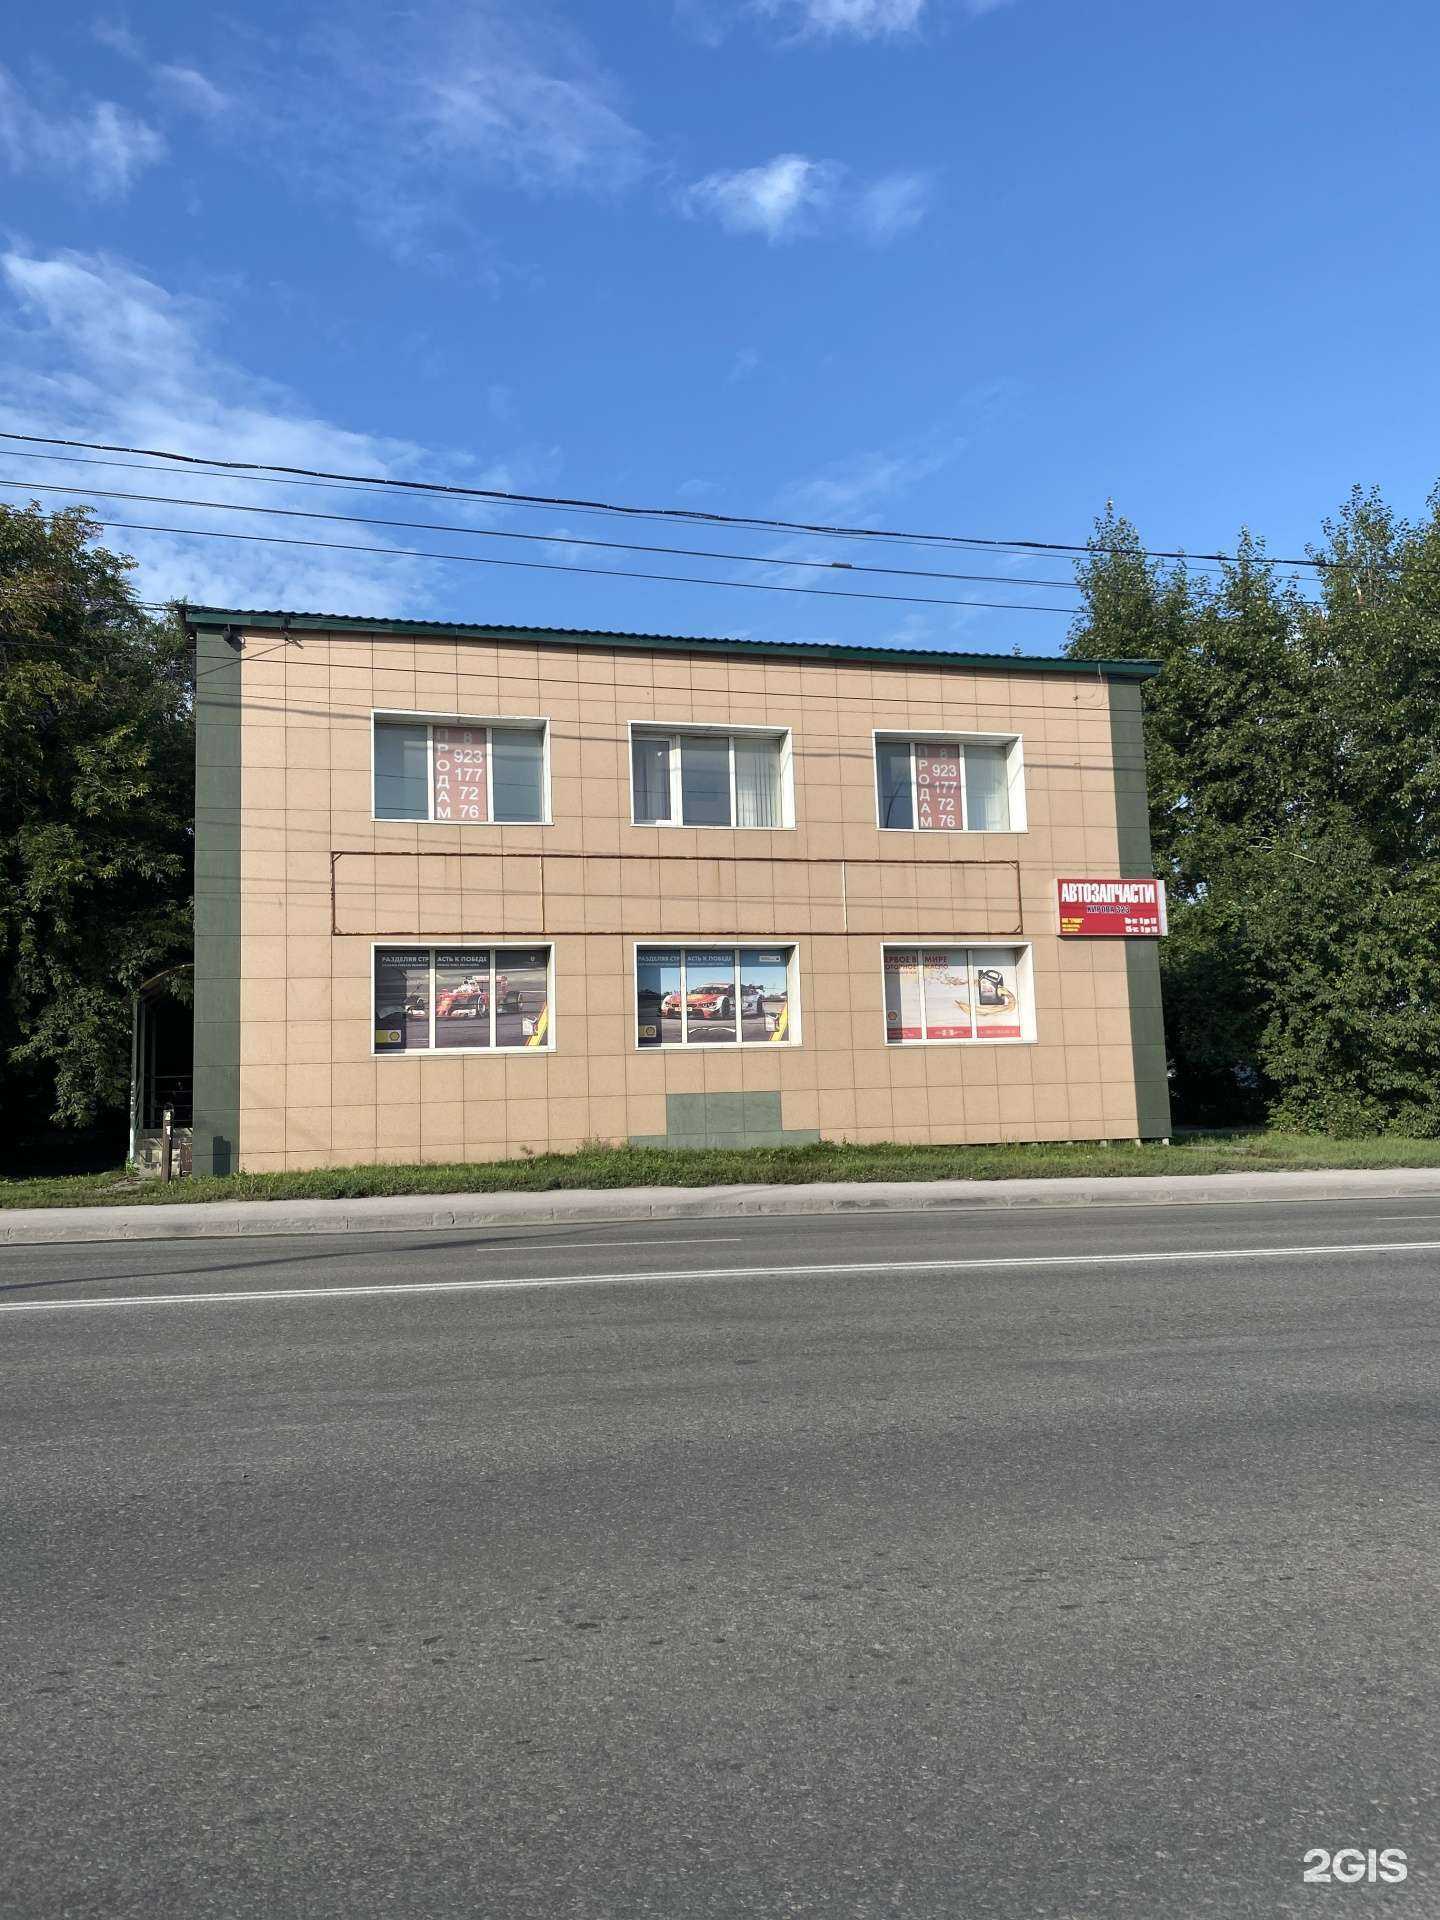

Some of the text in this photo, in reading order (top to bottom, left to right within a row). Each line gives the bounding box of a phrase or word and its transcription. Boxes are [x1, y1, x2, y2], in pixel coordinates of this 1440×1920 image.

[454, 749, 483, 763] 923
[436, 728, 451, 818] ПРОДАМ
[455, 767, 482, 782] 177
[932, 765, 957, 777] 923
[459, 786, 479, 800] 72
[934, 781, 957, 794] 177
[938, 798, 955, 811] 72
[459, 805, 480, 819] 76
[938, 815, 956, 828] 76
[1061, 883, 1155, 903] АВТОЗАПЧАСТИ
